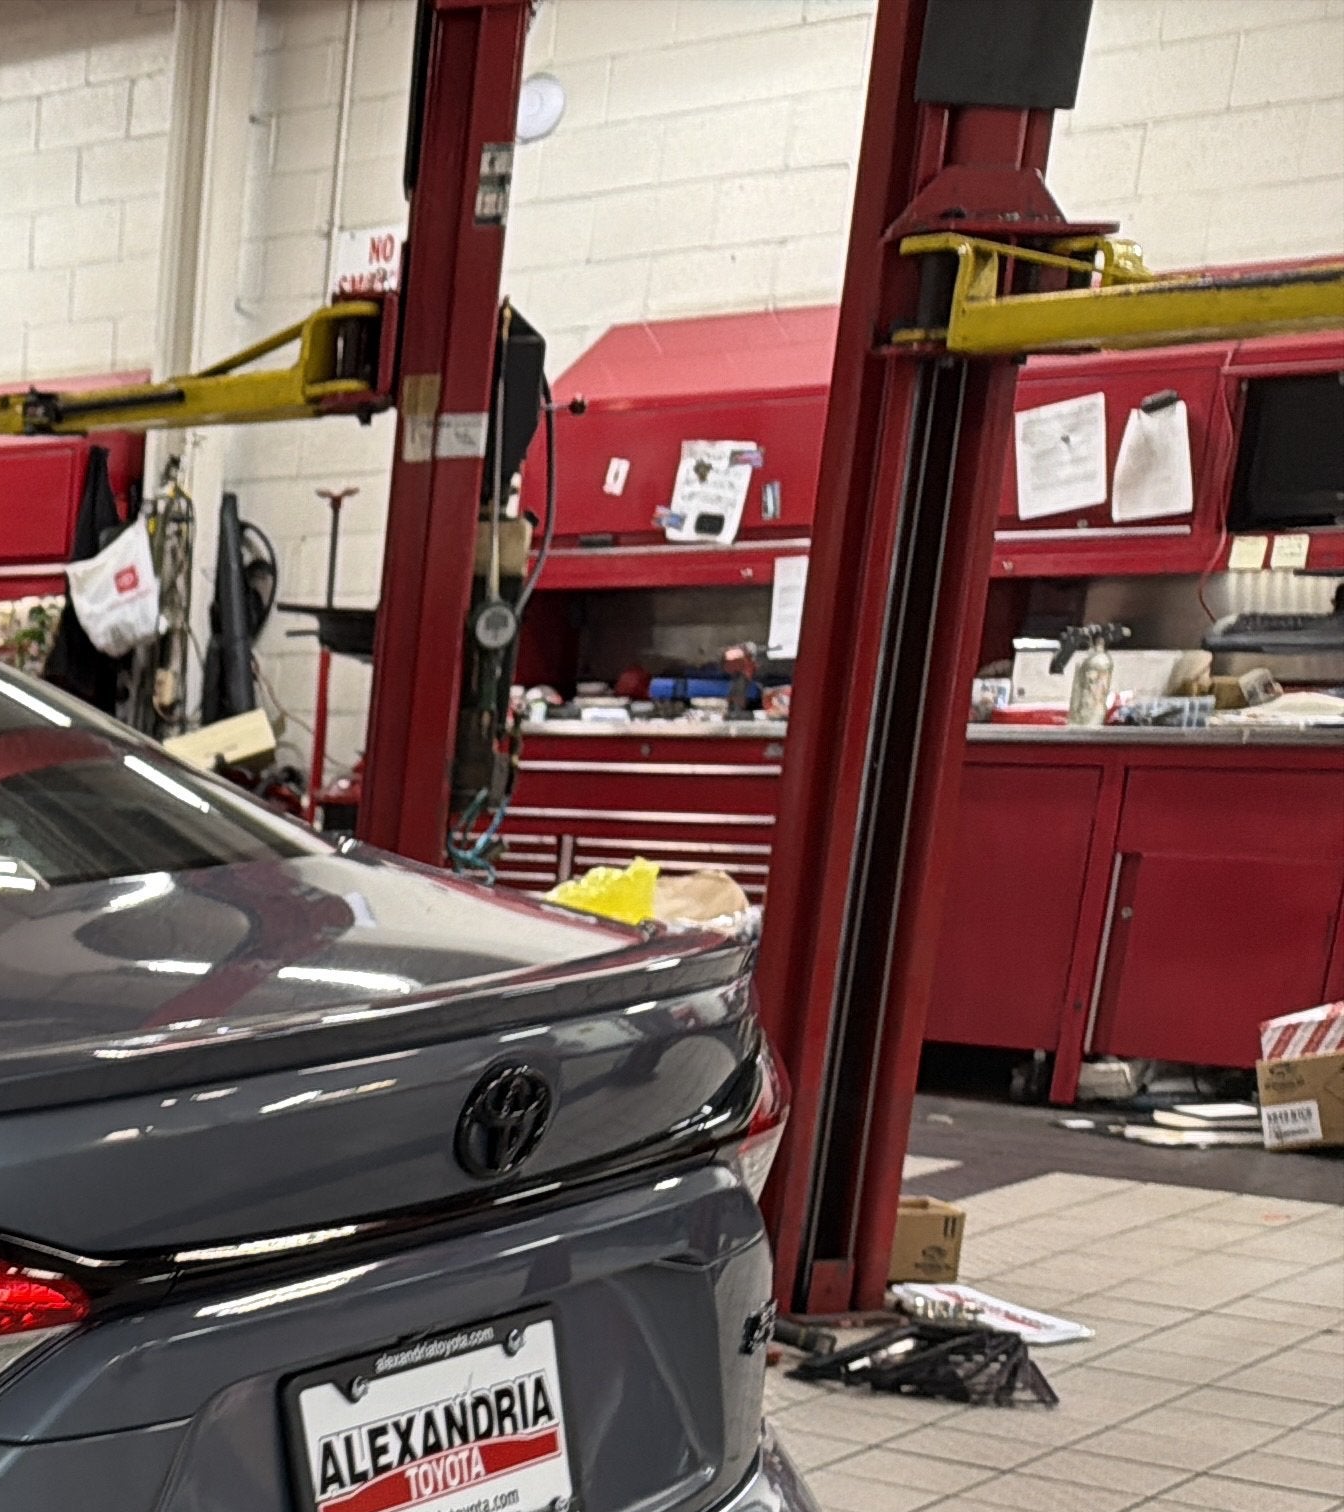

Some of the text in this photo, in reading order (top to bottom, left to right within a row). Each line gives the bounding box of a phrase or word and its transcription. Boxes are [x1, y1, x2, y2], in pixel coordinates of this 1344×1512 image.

[369, 233, 394, 265] NO
[375, 1326, 494, 1374] alexandriatoyota.com
[318, 1376, 555, 1498] ALEXANDRIA
[404, 1446, 486, 1499] TOYOTA
